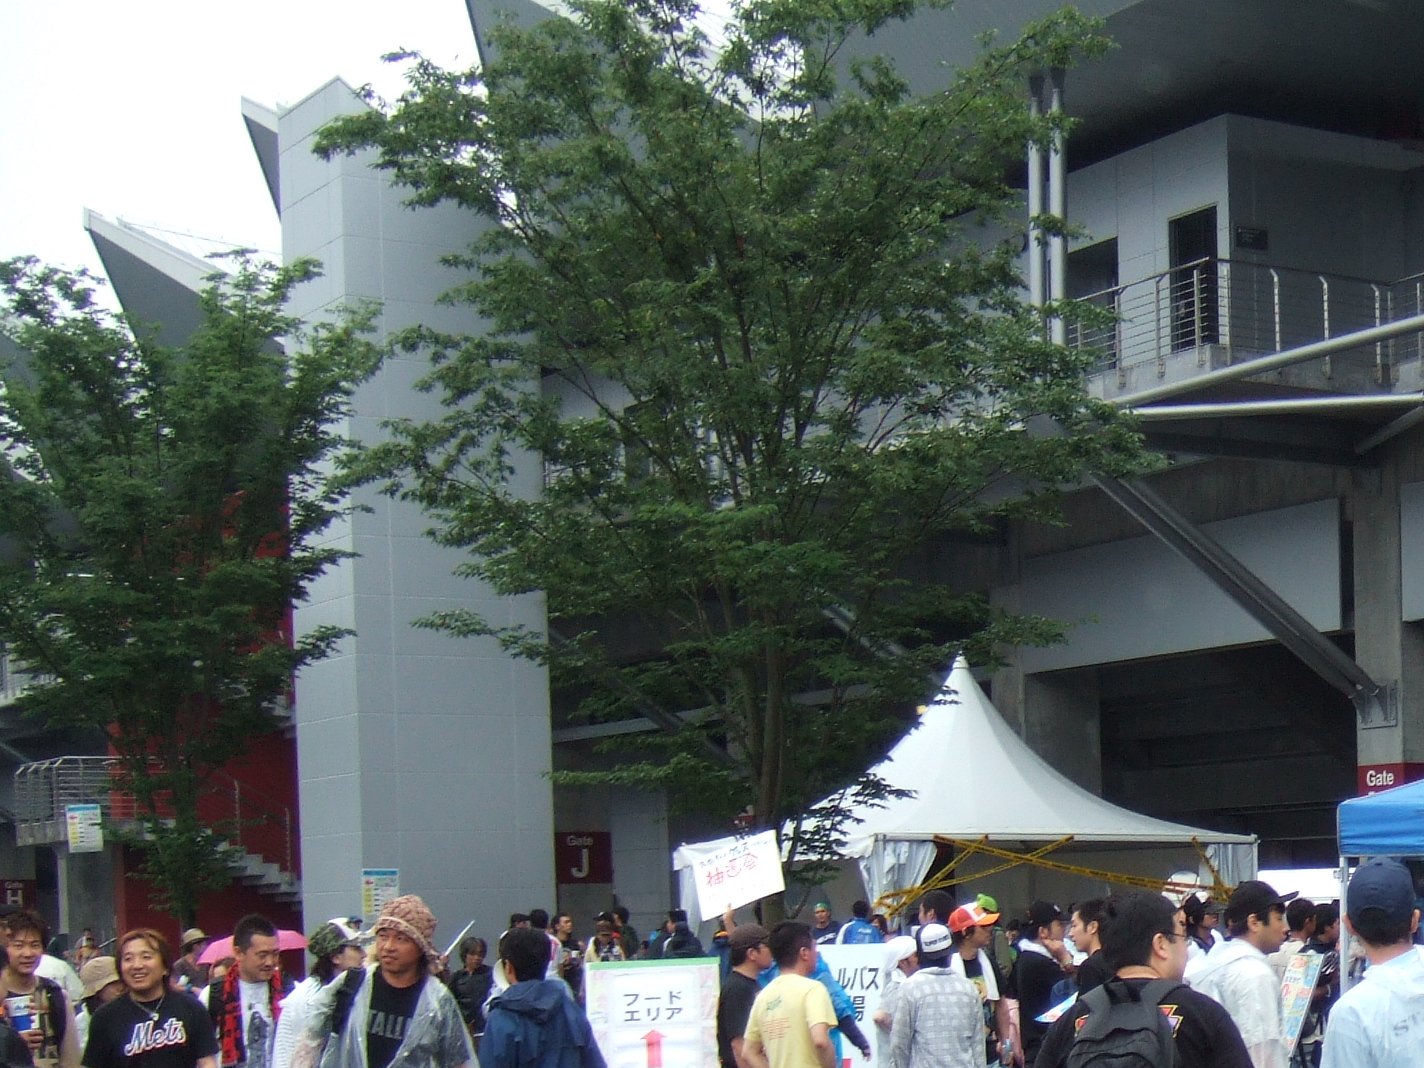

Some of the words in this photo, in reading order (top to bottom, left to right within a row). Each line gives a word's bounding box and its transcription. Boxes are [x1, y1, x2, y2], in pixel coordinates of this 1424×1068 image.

[1366, 770, 1394, 787] Gate
[567, 835, 593, 847] Gate
[571, 848, 589, 878] J
[623, 991, 682, 1007] フード
[624, 1007, 683, 1022] エリア
[124, 1018, 187, 1056] Mets
